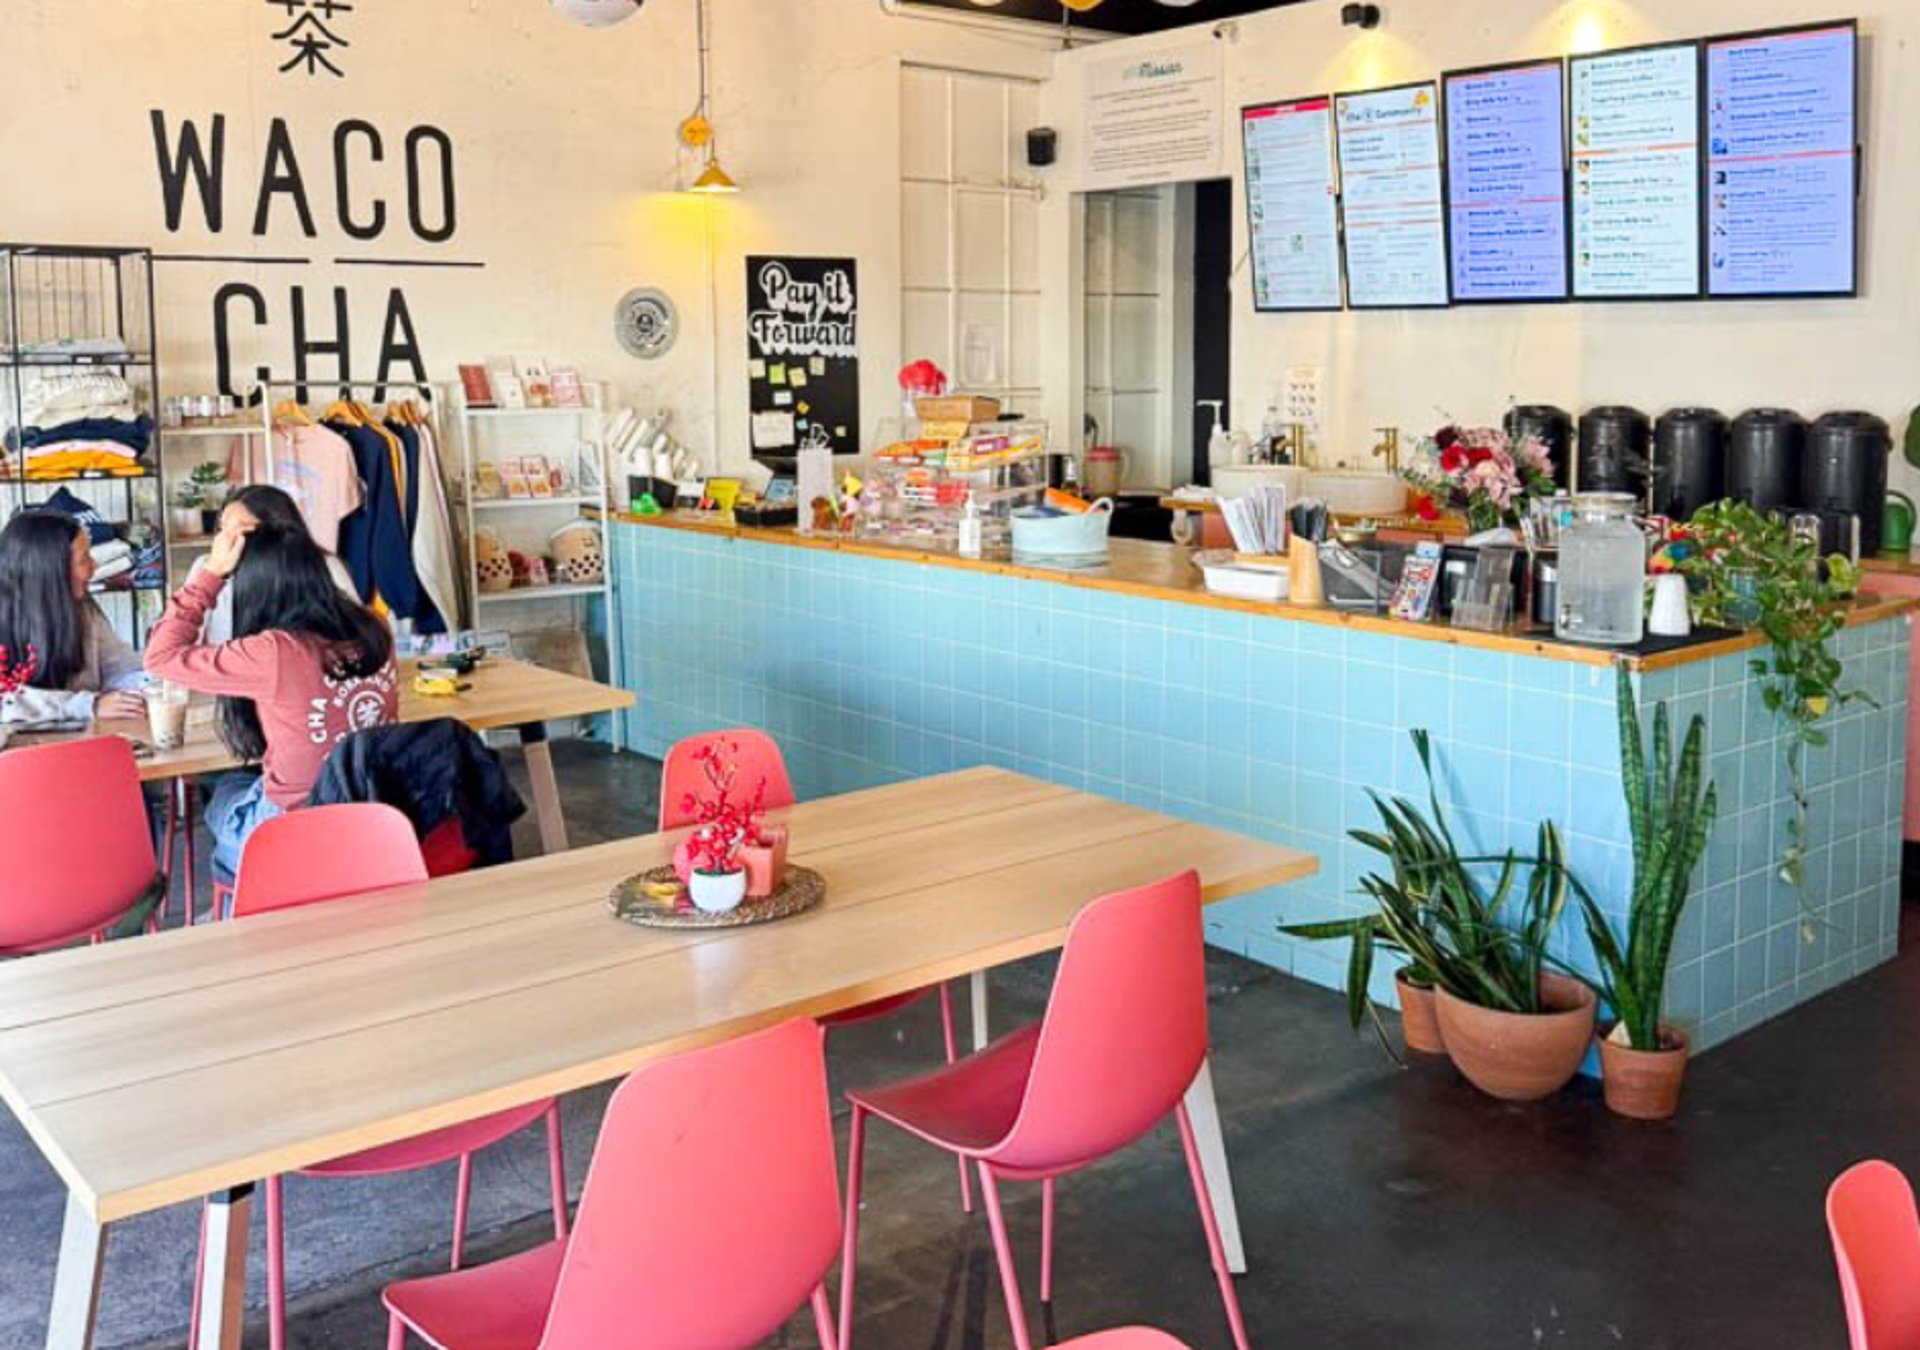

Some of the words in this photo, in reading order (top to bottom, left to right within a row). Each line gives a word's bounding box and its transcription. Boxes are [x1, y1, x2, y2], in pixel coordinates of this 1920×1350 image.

[266, 0, 353, 78] 茶
[149, 108, 457, 243] WACO
[760, 262, 822, 322] Pay
[824, 270, 850, 309] it
[213, 282, 433, 408] CHA
[750, 312, 857, 351] Forward
[307, 698, 328, 743] CHA
